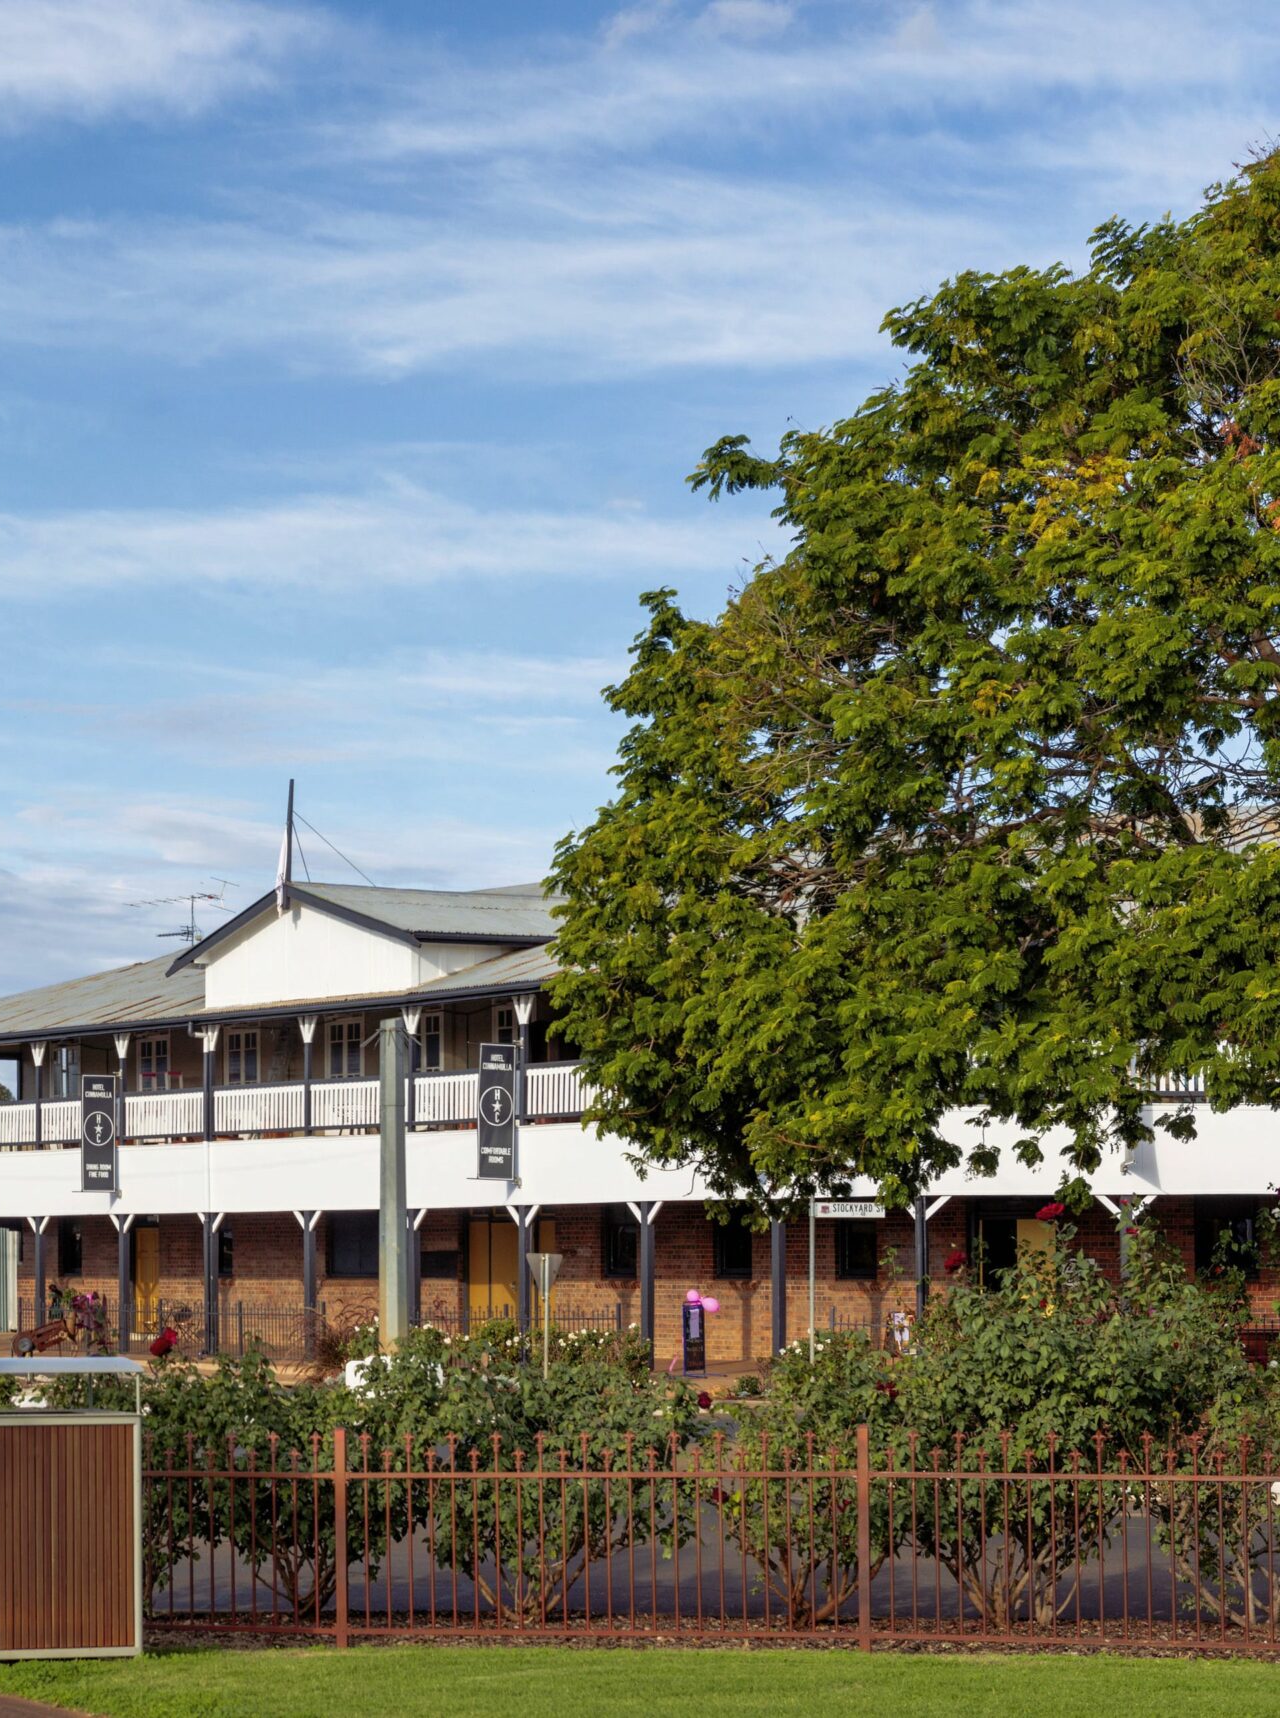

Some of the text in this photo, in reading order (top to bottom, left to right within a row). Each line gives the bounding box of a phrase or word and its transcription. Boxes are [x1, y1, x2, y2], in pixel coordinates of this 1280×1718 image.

[490, 1054, 504, 1062] HOTEL
[494, 1088, 501, 1123] H C
[96, 1113, 102, 1143] H C
[480, 1147, 512, 1156] COMFORTABLE
[488, 1156, 504, 1164] ROOMS
[832, 1204, 873, 1213] STOCKYARD
